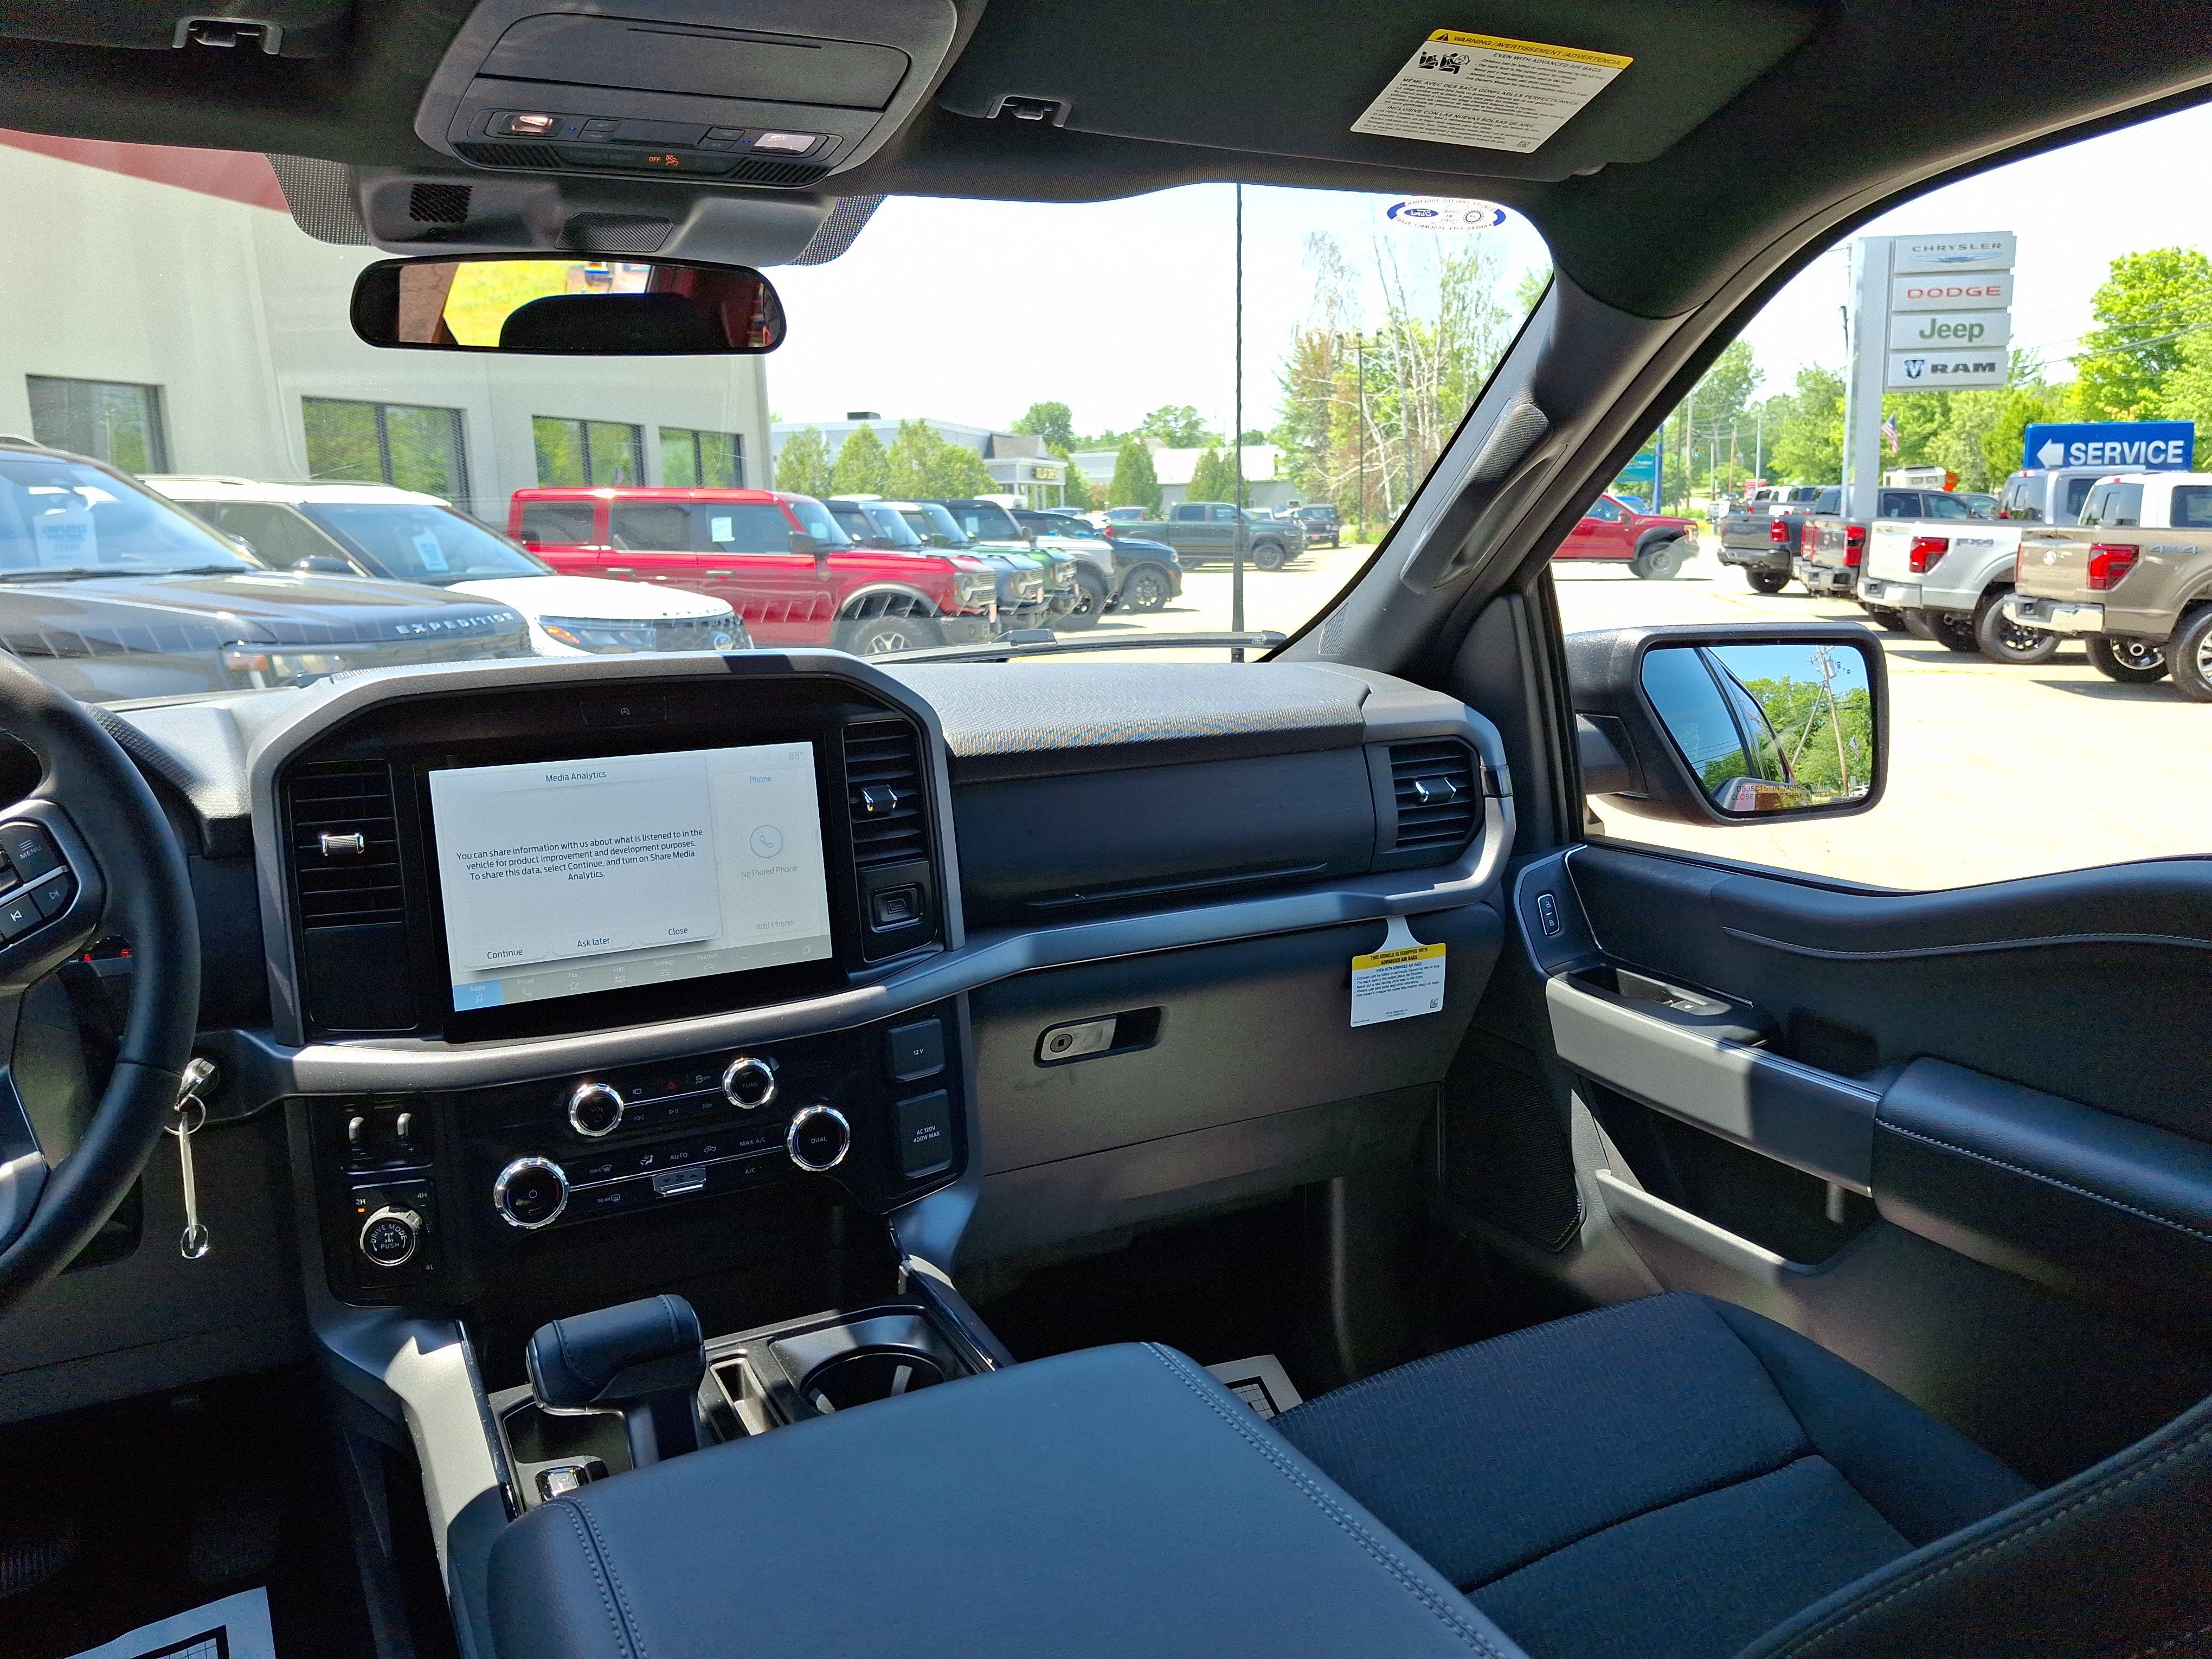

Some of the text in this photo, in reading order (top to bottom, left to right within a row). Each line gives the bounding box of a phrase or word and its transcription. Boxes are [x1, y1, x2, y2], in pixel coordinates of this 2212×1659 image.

[1531, 59, 1569, 67] ADVANCED
[1912, 243, 2002, 253] CHRYSLER
[1907, 286, 2001, 299] DODGE
[1919, 318, 1984, 343] Jeep
[1930, 362, 1996, 374] RAM
[2068, 440, 2185, 466] SERVICE
[545, 770, 606, 782] Media Analytics
[749, 775, 771, 783] Phone
[456, 852, 472, 860] You
[489, 848, 511, 857] share
[512, 844, 560, 854] information
[560, 840, 578, 850] with
[590, 838, 613, 847] about
[613, 835, 634, 844] what
[642, 831, 672, 841] listened
[20, 846, 42, 860] MENU
[466, 840, 696, 870] vehicle for product improvement and development purposes.
[469, 872, 480, 880] To
[481, 871, 504, 879] share
[505, 868, 520, 877] this
[522, 866, 542, 875] data,
[543, 863, 567, 873] select
[568, 860, 605, 870] Continue,
[606, 857, 621, 866] and
[650, 853, 672, 861] Share
[672, 850, 695, 859] Media
[568, 870, 606, 880] Analytics.
[741, 864, 798, 878] No Paired Phone
[756, 920, 794, 930] Add Phone
[668, 927, 688, 936] Close
[577, 937, 610, 948] Ask later
[487, 949, 523, 959] Continue
[654, 959, 676, 967] Settings
[913, 1135, 928, 1143] 400W
[670, 1152, 689, 1160] AUTO
[370, 1223, 407, 1244] DRIVE MODE
